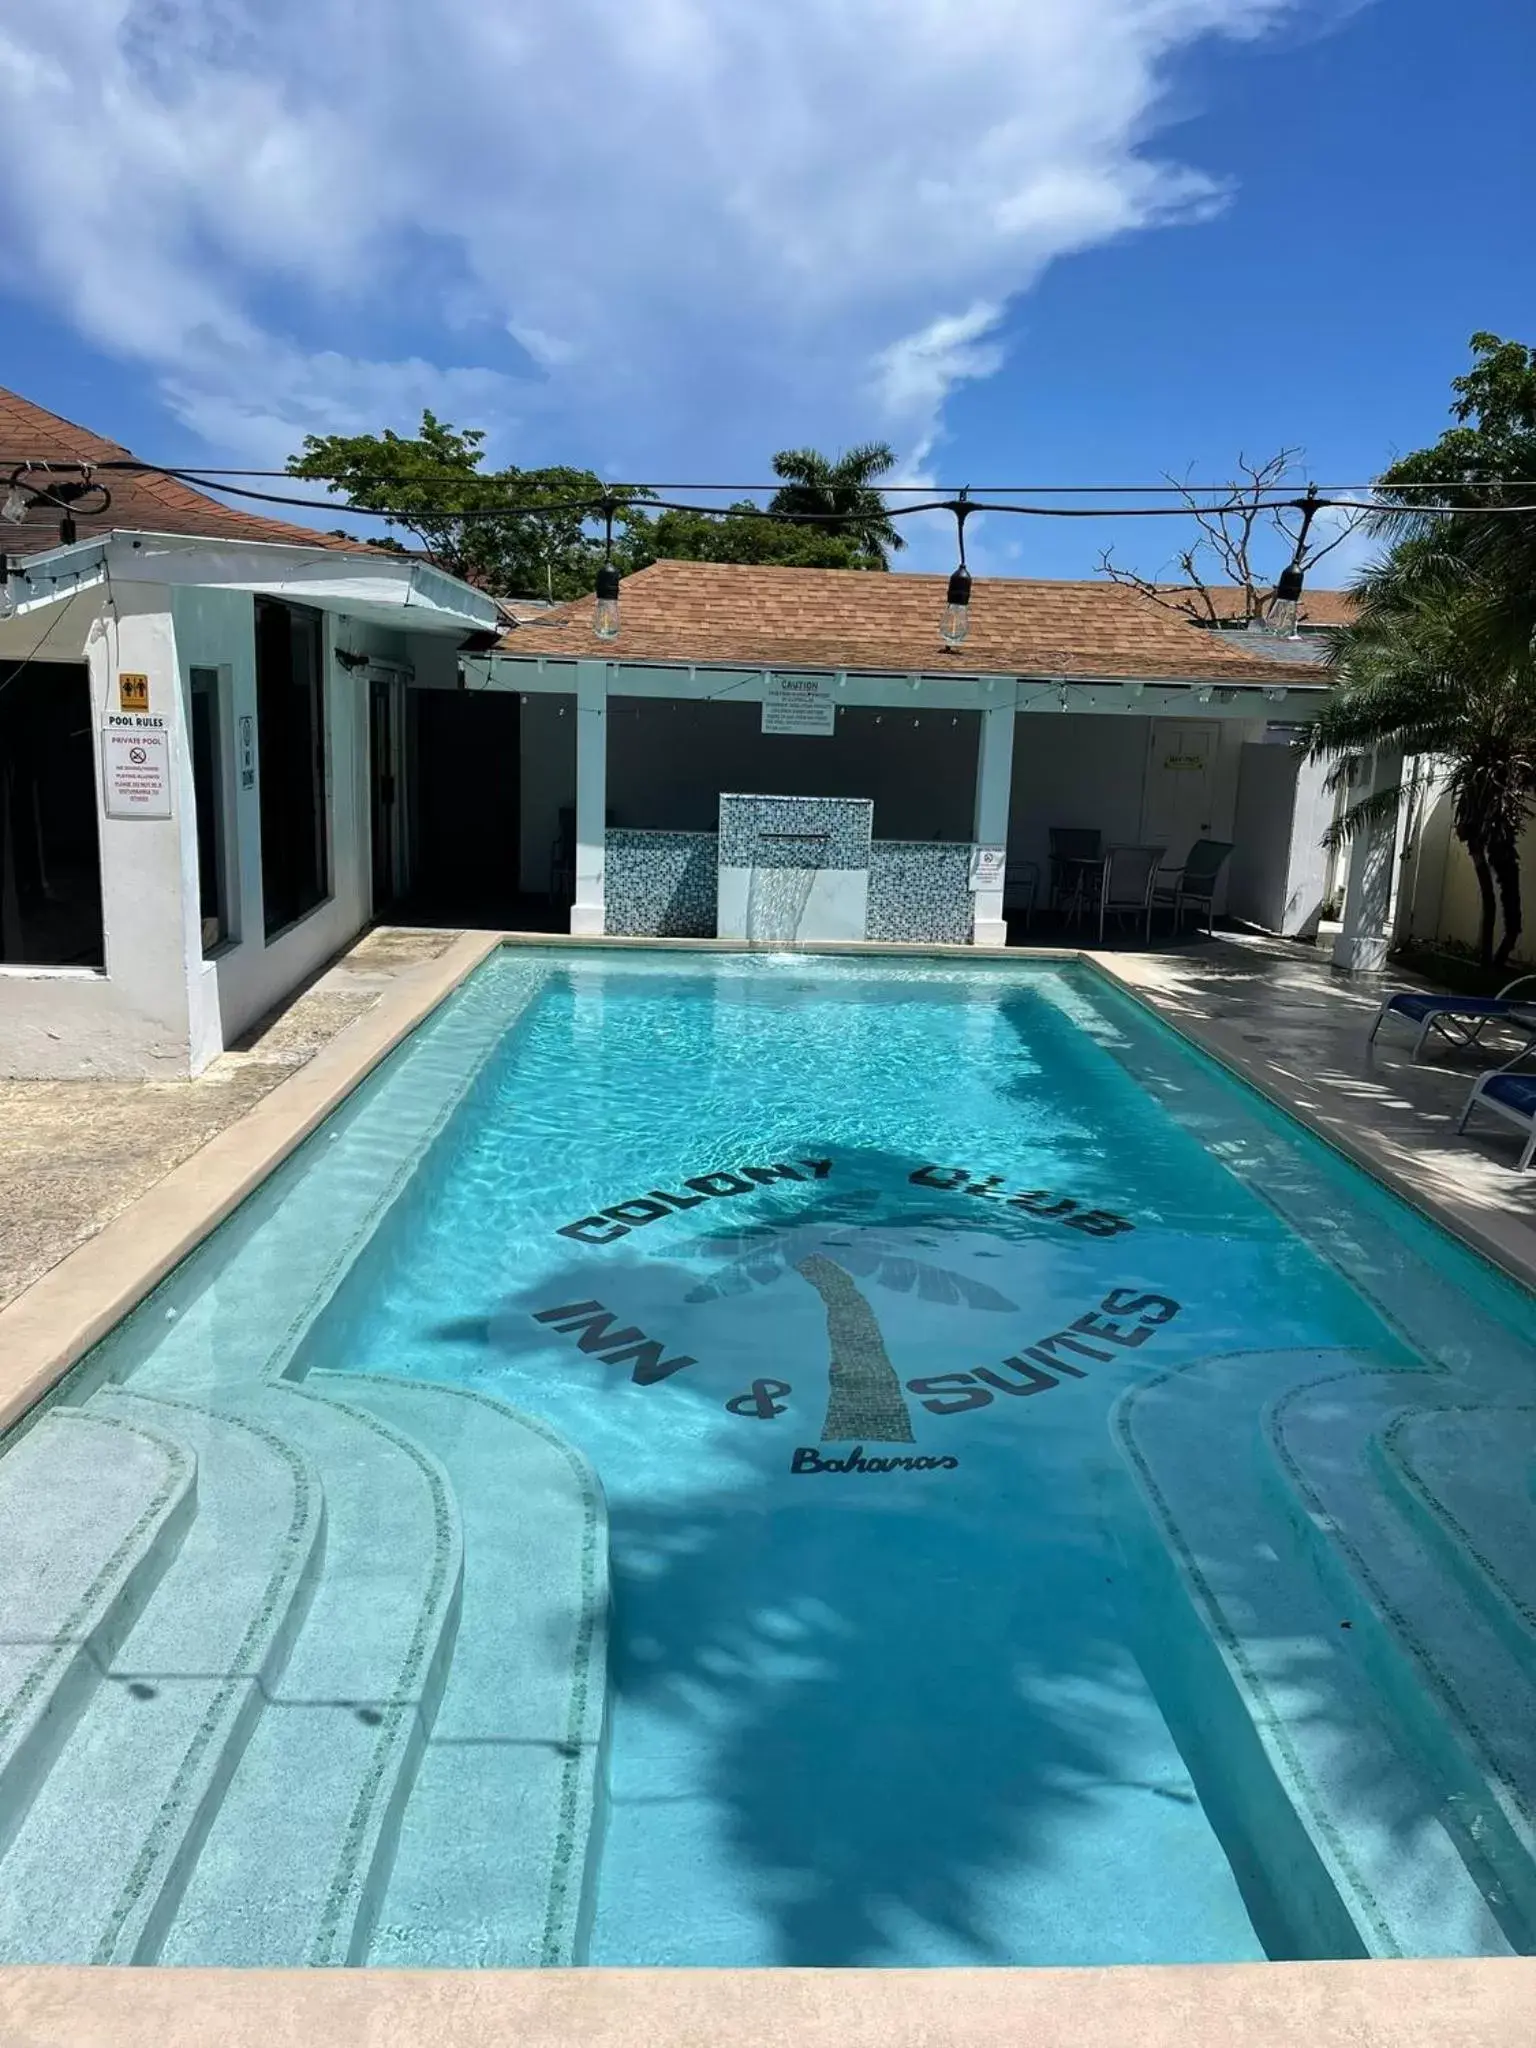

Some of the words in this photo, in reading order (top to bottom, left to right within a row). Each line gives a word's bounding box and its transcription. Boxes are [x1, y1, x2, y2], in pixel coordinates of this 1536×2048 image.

[781, 680, 819, 689] CAUTION
[109, 716, 133, 726] POOL
[136, 717, 163, 727] RULES
[111, 737, 140, 745] PRIVATE
[142, 738, 162, 746] POOL
[556, 1158, 833, 1245] COLONY
[908, 1166, 1137, 1237] CLUB
[532, 1301, 698, 1386] INN
[725, 1378, 792, 1420] &
[906, 1288, 1182, 1416] SUITES
[790, 1445, 960, 1475] Bahamas
